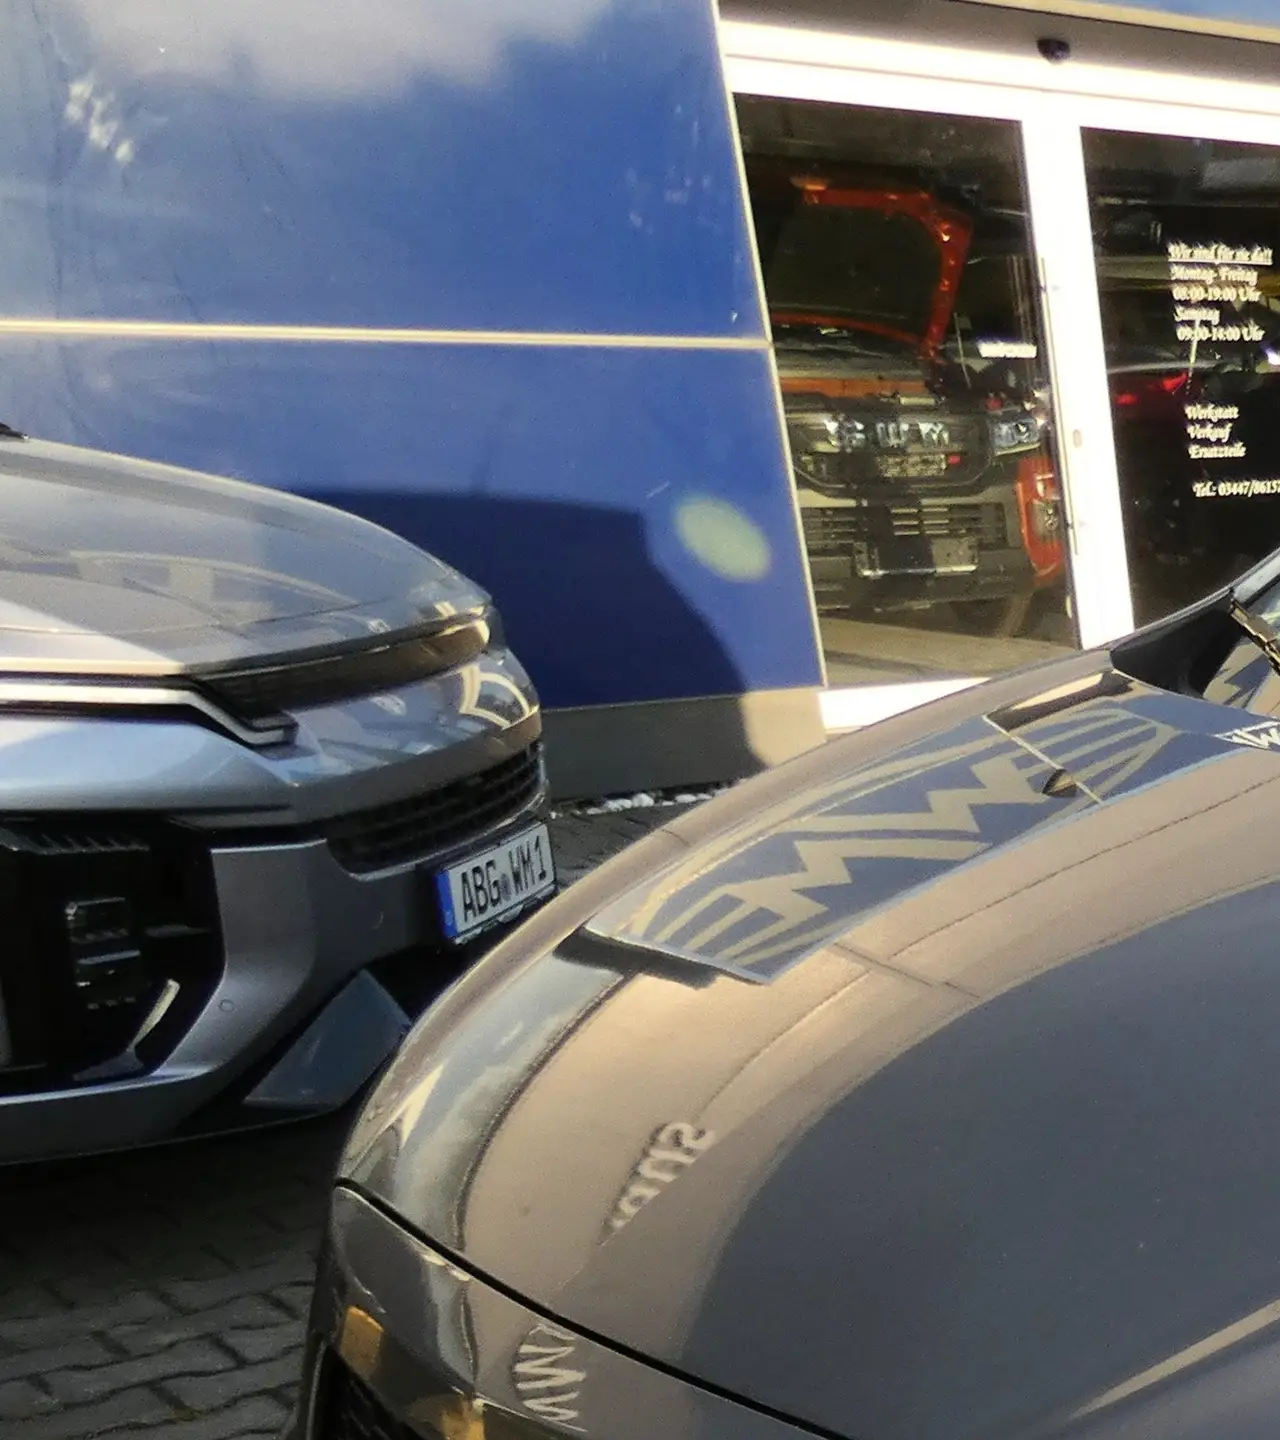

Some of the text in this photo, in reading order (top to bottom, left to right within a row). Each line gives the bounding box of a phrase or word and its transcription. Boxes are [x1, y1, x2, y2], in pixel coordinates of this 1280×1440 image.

[1238, 285, 1262, 302] Uhr
[1242, 319, 1265, 341] Uhr
[1184, 403, 1239, 422] Werkstatt
[1187, 421, 1233, 443] Verkauf
[460, 859, 501, 922] ABG
